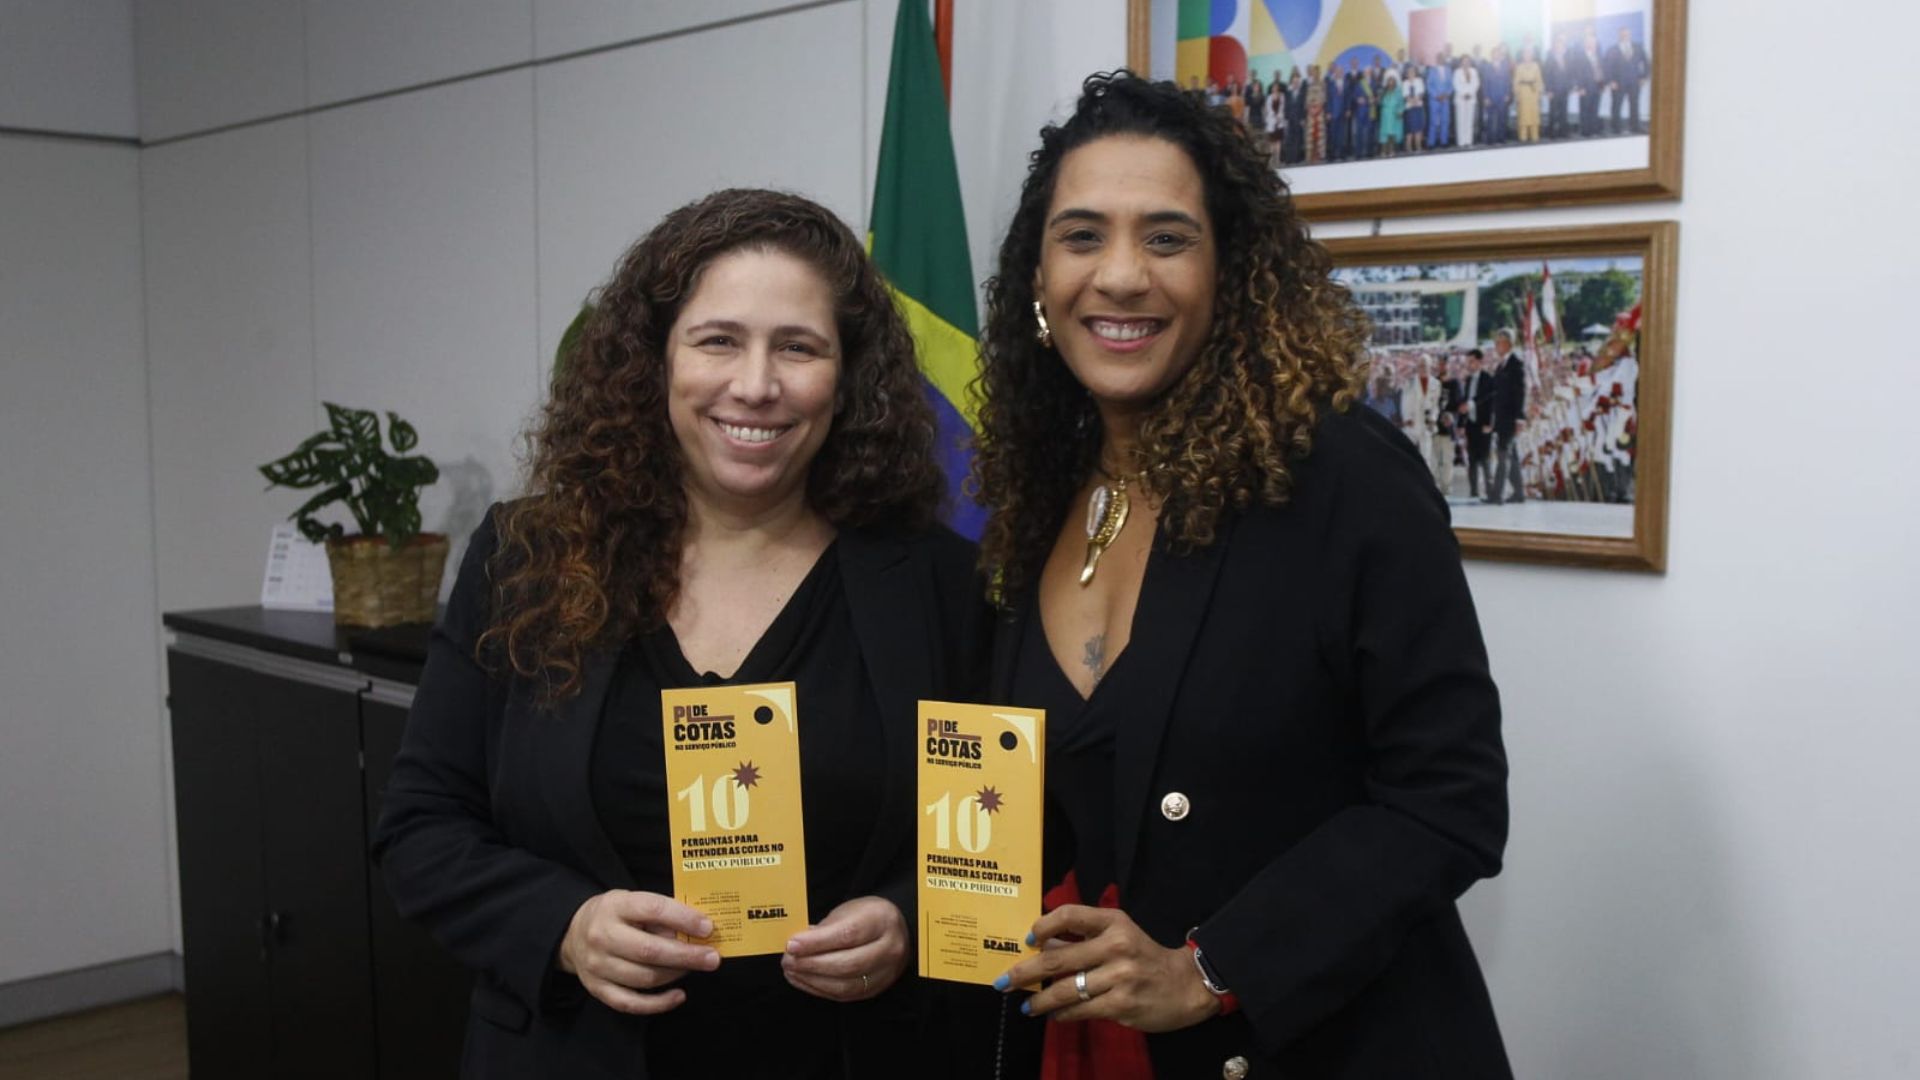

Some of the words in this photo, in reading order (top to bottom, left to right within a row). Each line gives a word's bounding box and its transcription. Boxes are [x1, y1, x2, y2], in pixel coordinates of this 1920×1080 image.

[693, 704, 709, 717] DE
[674, 722, 736, 742] COTAS
[944, 720, 958, 733] DE
[927, 737, 982, 760] COTAS
[677, 774, 750, 832] 10
[926, 791, 992, 853] 10
[682, 835, 733, 847] PERGUNTAS
[735, 834, 758, 844] PARA
[682, 847, 728, 858] ENTENDER
[728, 846, 740, 855] AS
[741, 844, 770, 855] COTAS
[771, 843, 784, 852] NO
[927, 854, 974, 867] PERGUNTAS
[976, 860, 998, 870] PARA
[927, 865, 969, 878] ENTENDER
[970, 870, 980, 880] AS
[982, 872, 1009, 883] COTAS
[1010, 875, 1022, 884] NO
[747, 908, 788, 920] BRASIL
[983, 939, 1022, 953] BRASIL
